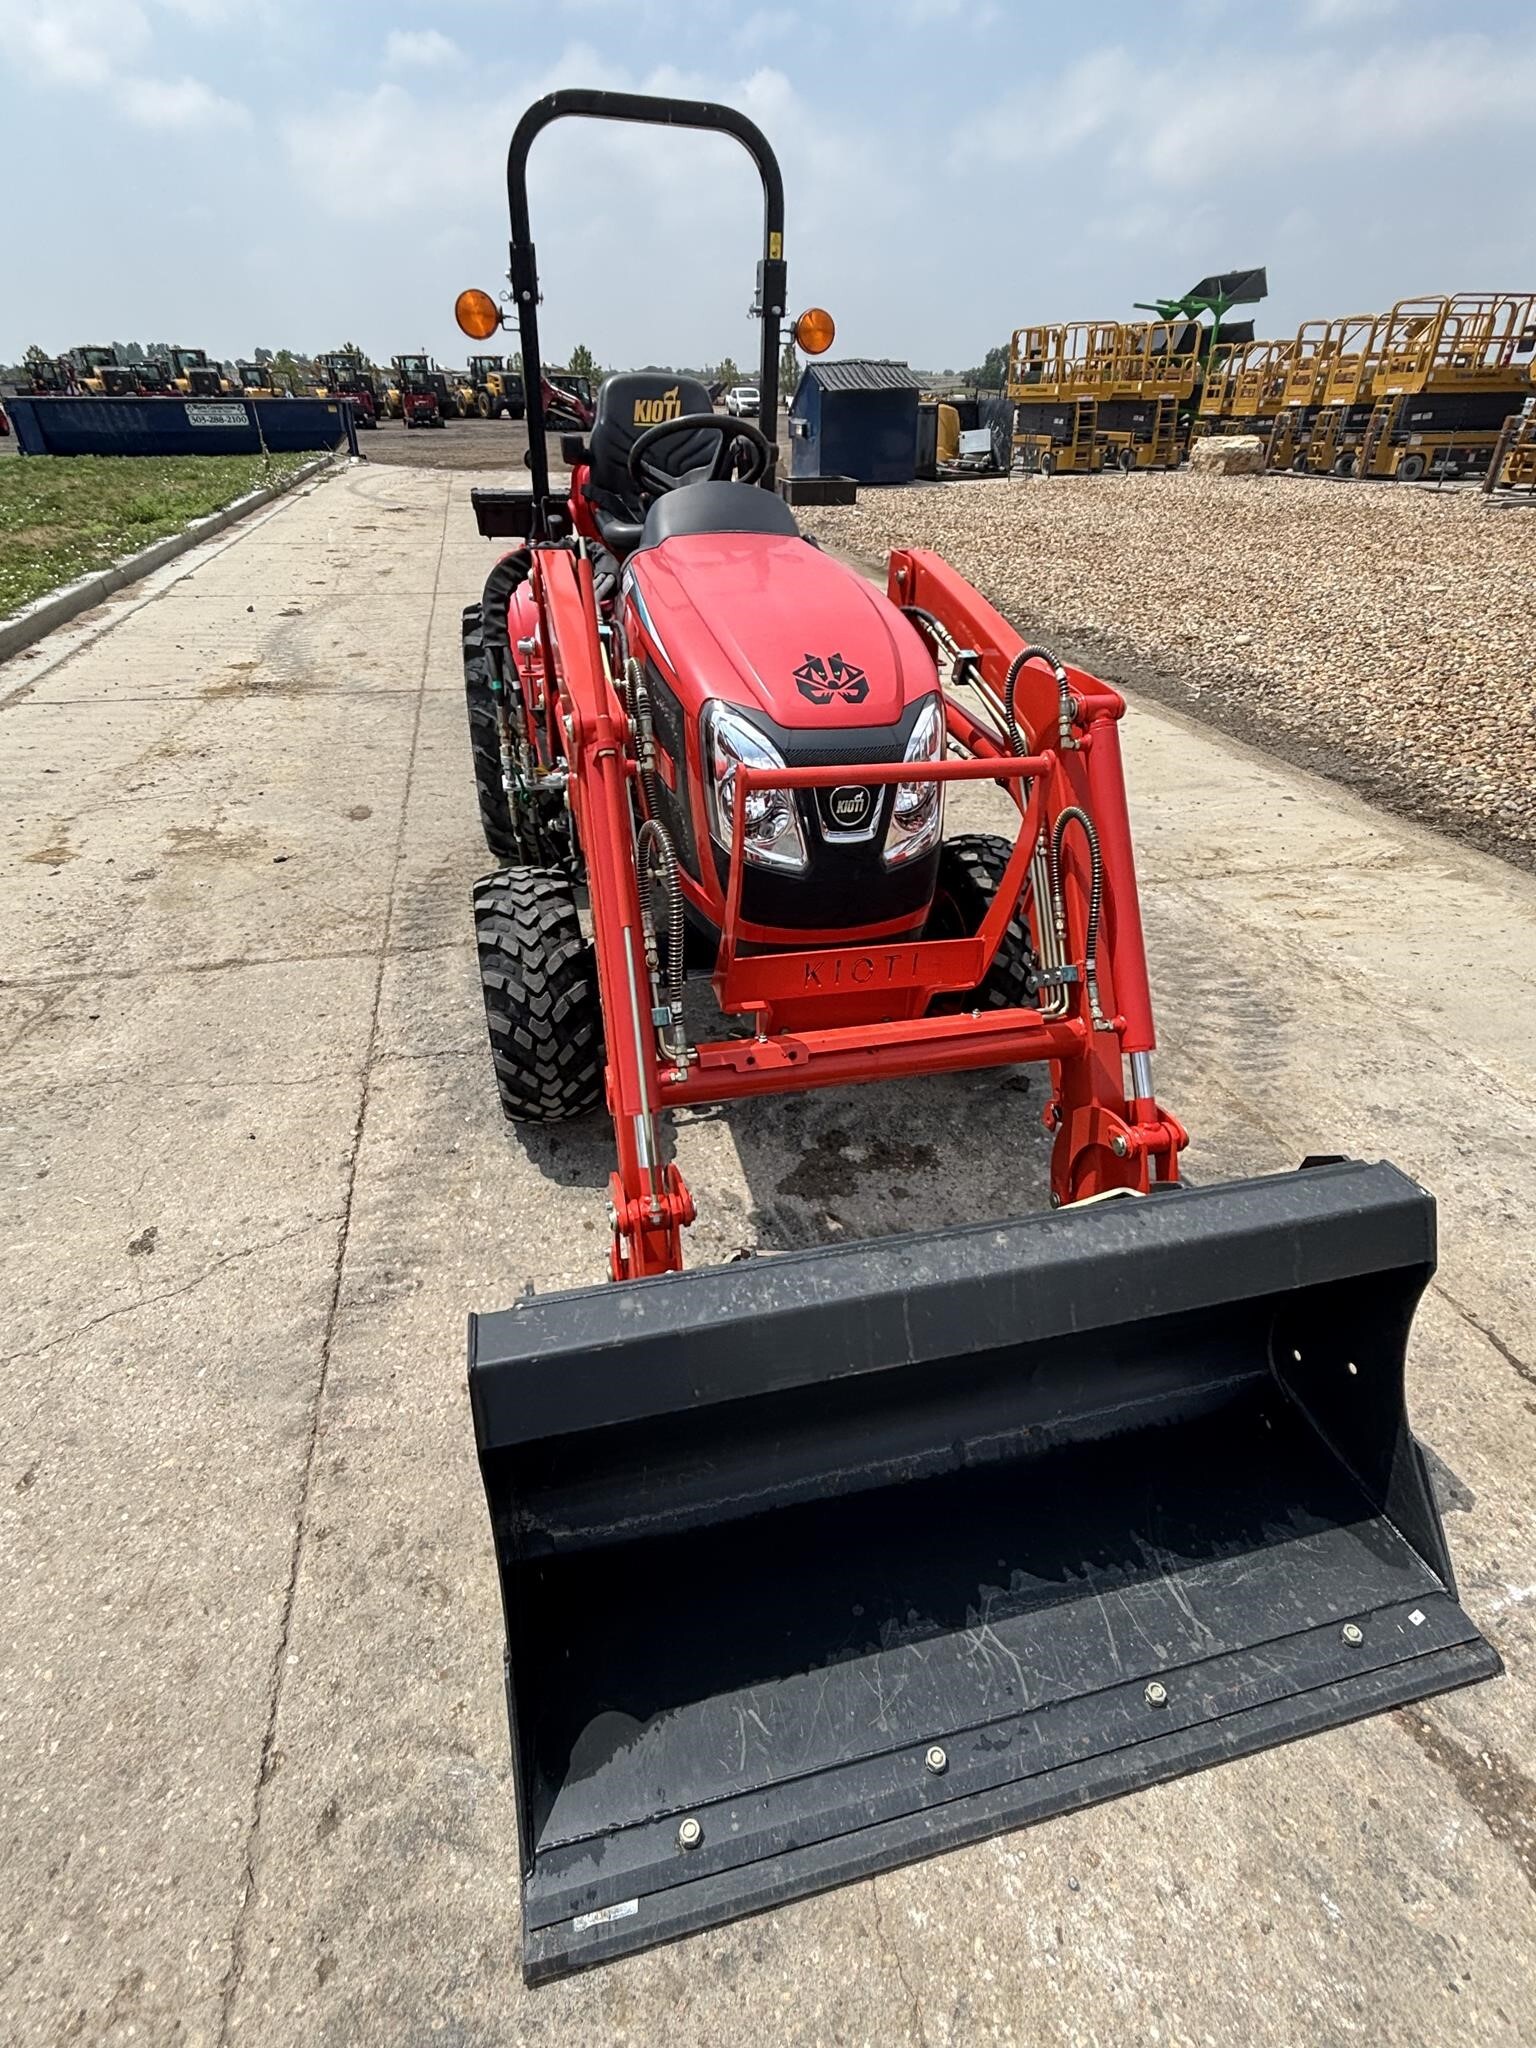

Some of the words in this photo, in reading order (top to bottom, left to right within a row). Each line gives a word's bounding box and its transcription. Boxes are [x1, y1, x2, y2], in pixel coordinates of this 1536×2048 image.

[633, 399, 681, 422] KIOTI
[836, 799, 865, 813] KIOTI
[804, 952, 919, 988] KIOTI
